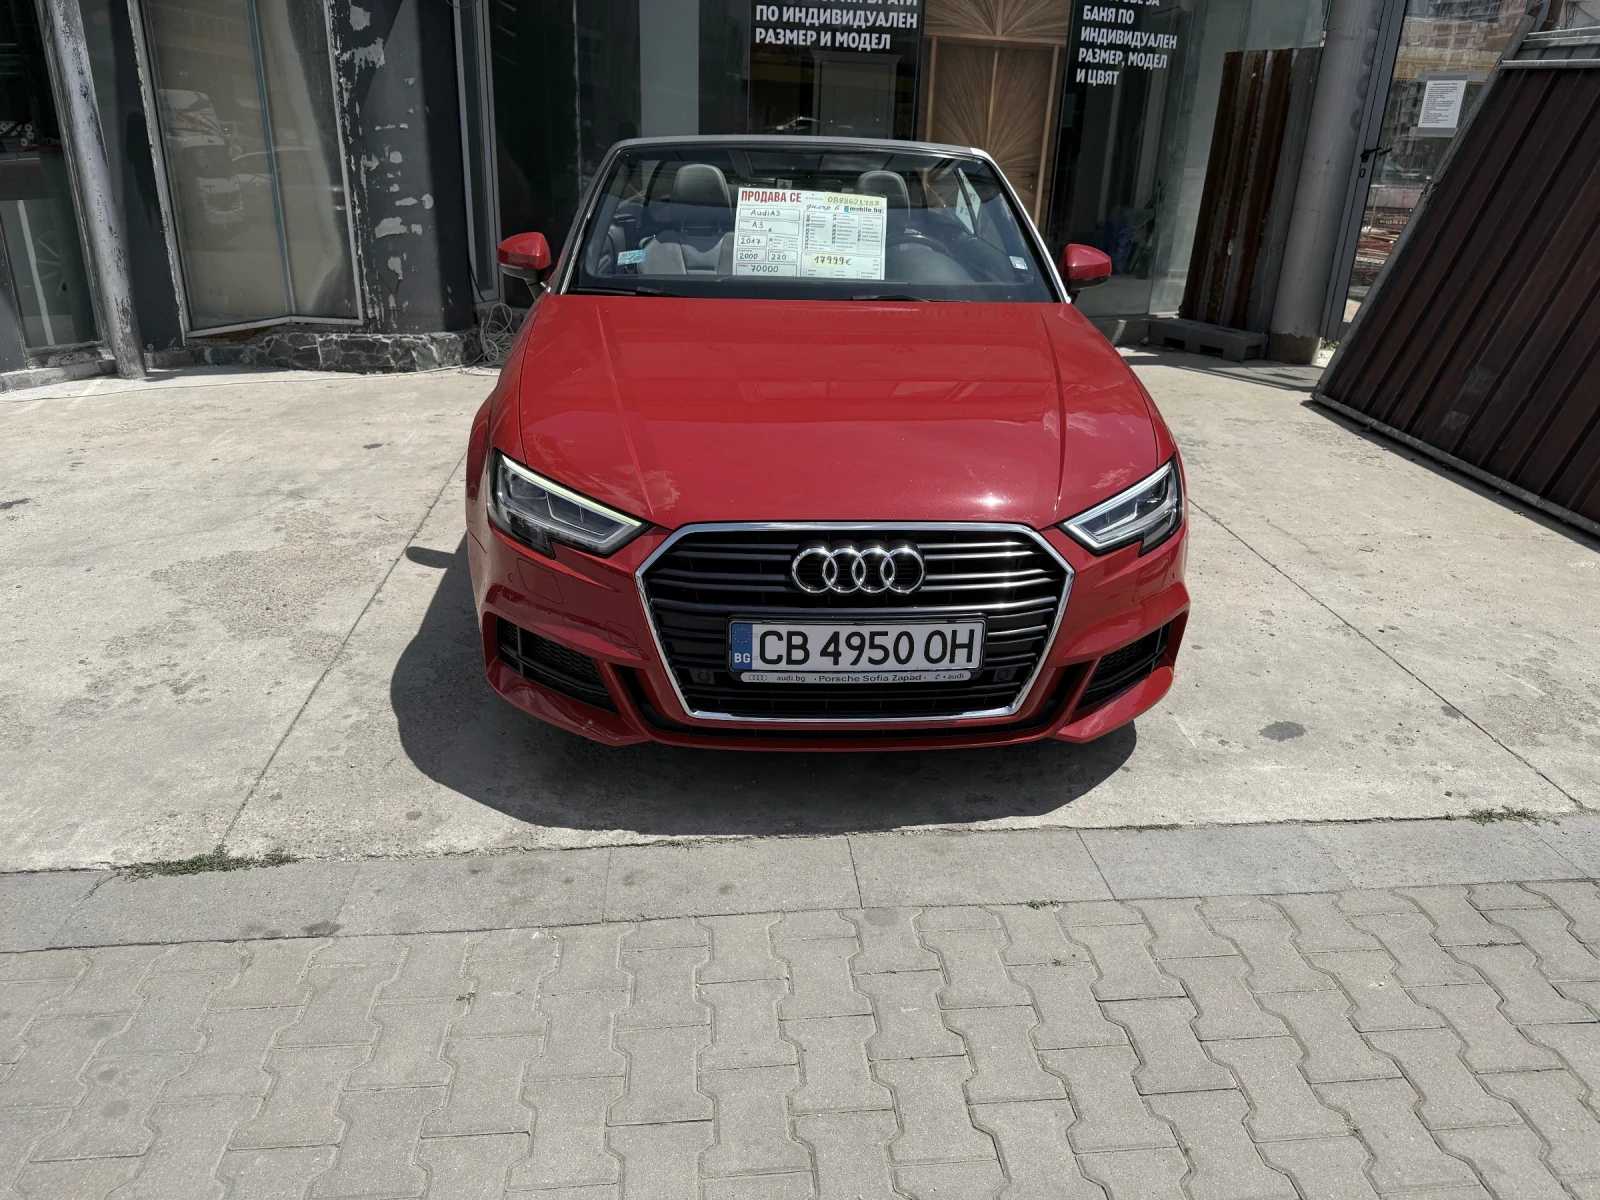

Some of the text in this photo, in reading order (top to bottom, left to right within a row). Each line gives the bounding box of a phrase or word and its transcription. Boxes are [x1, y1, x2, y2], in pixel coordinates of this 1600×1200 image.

[755, 5, 918, 29] ПО ИНДИВИДУАЛЕН
[1083, 5, 1135, 25] БАНЯ ПО
[755, 28, 891, 51] РАЗМЕР И МОДЕЛ
[1080, 26, 1178, 49] ИНДИВИДУАЛЕН
[1078, 47, 1168, 71] РАЗМЕР, МОДЕЛ
[1075, 68, 1120, 87] И ЦВЯТ
[741, 190, 787, 203] ПРОДАВА
[789, 192, 802, 203] СЕ
[740, 237, 761, 245] 2017
[739, 252, 758, 260] 2000
[759, 628, 975, 666] CB 4950 OH
[734, 652, 751, 664] BG
[776, 674, 806, 683] audi.bg
[818, 674, 860, 683] Porsche
[862, 674, 889, 682] Sofia
[892, 673, 922, 683] Zapad
